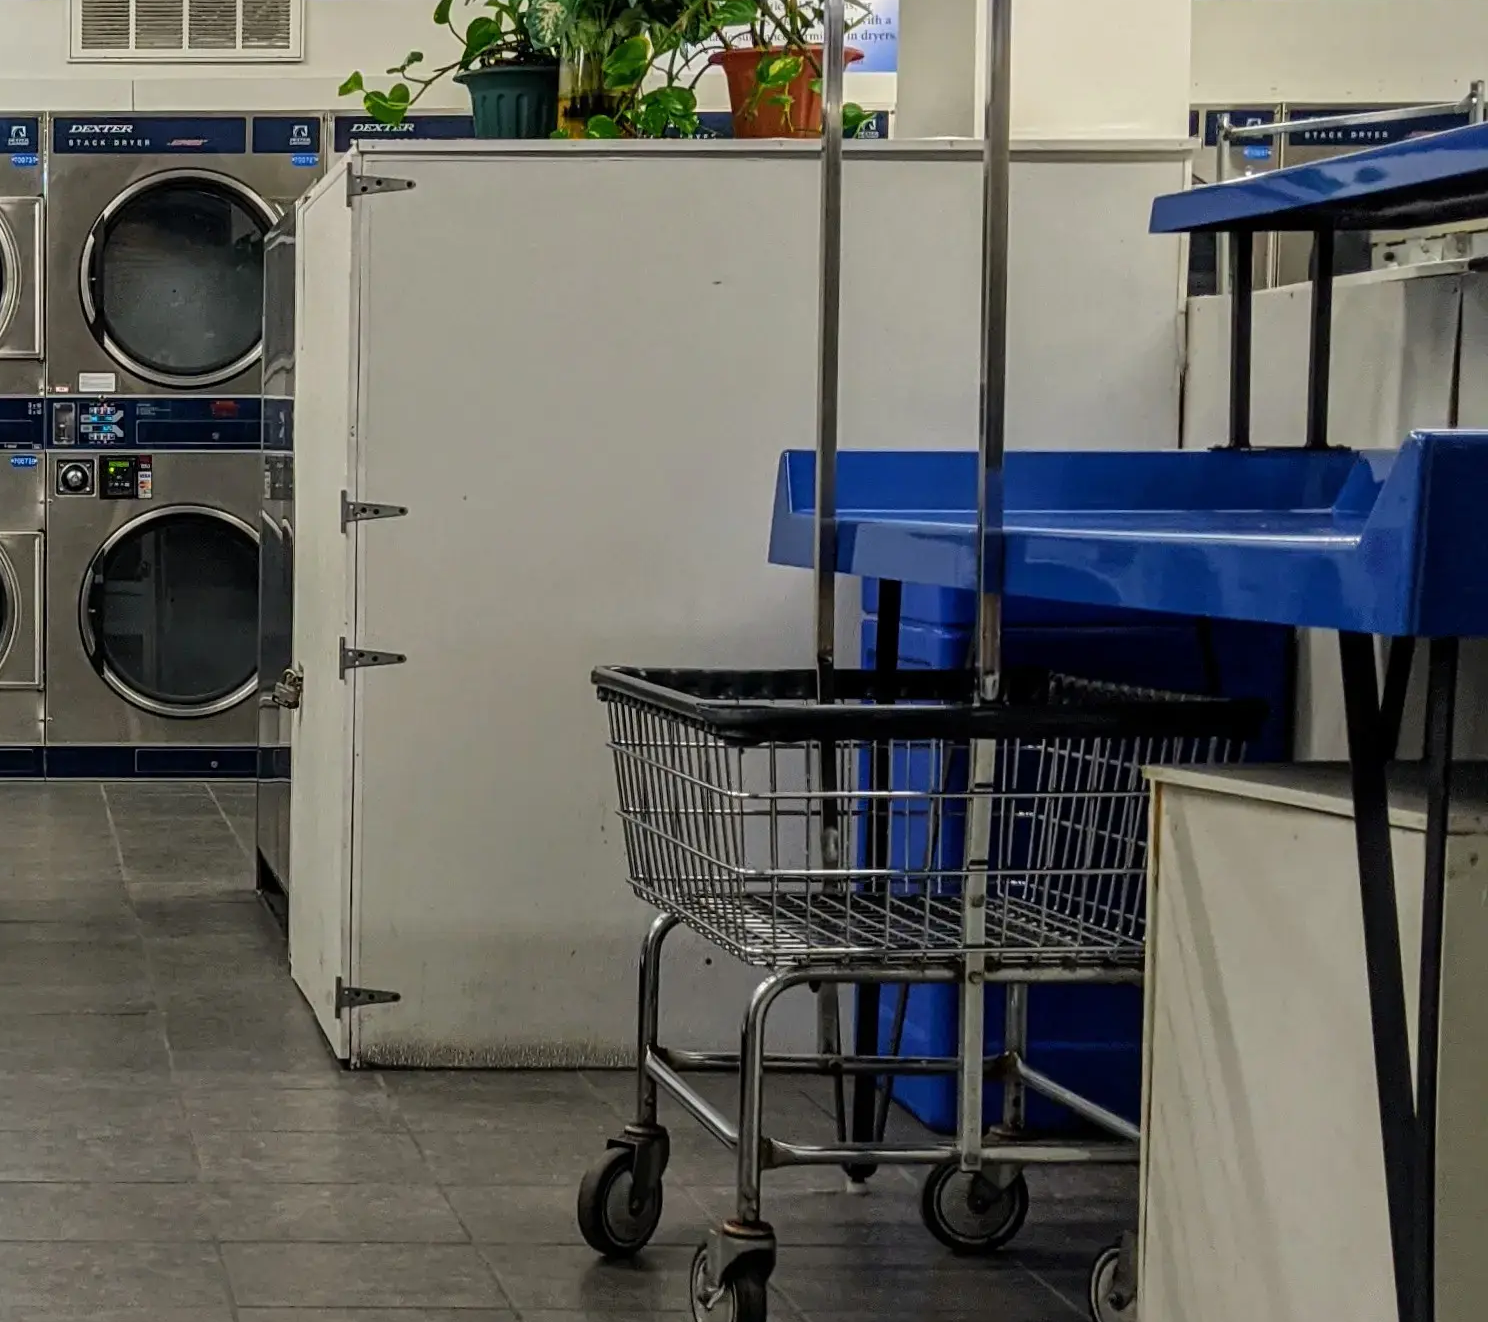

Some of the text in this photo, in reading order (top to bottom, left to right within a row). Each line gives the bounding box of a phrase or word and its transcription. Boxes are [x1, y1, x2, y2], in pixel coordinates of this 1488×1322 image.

[847, 32, 857, 41] in
[68, 124, 133, 133] DEXTER
[1304, 130, 1389, 139] STACK DRYER
[68, 139, 150, 147] STACK DRYER
